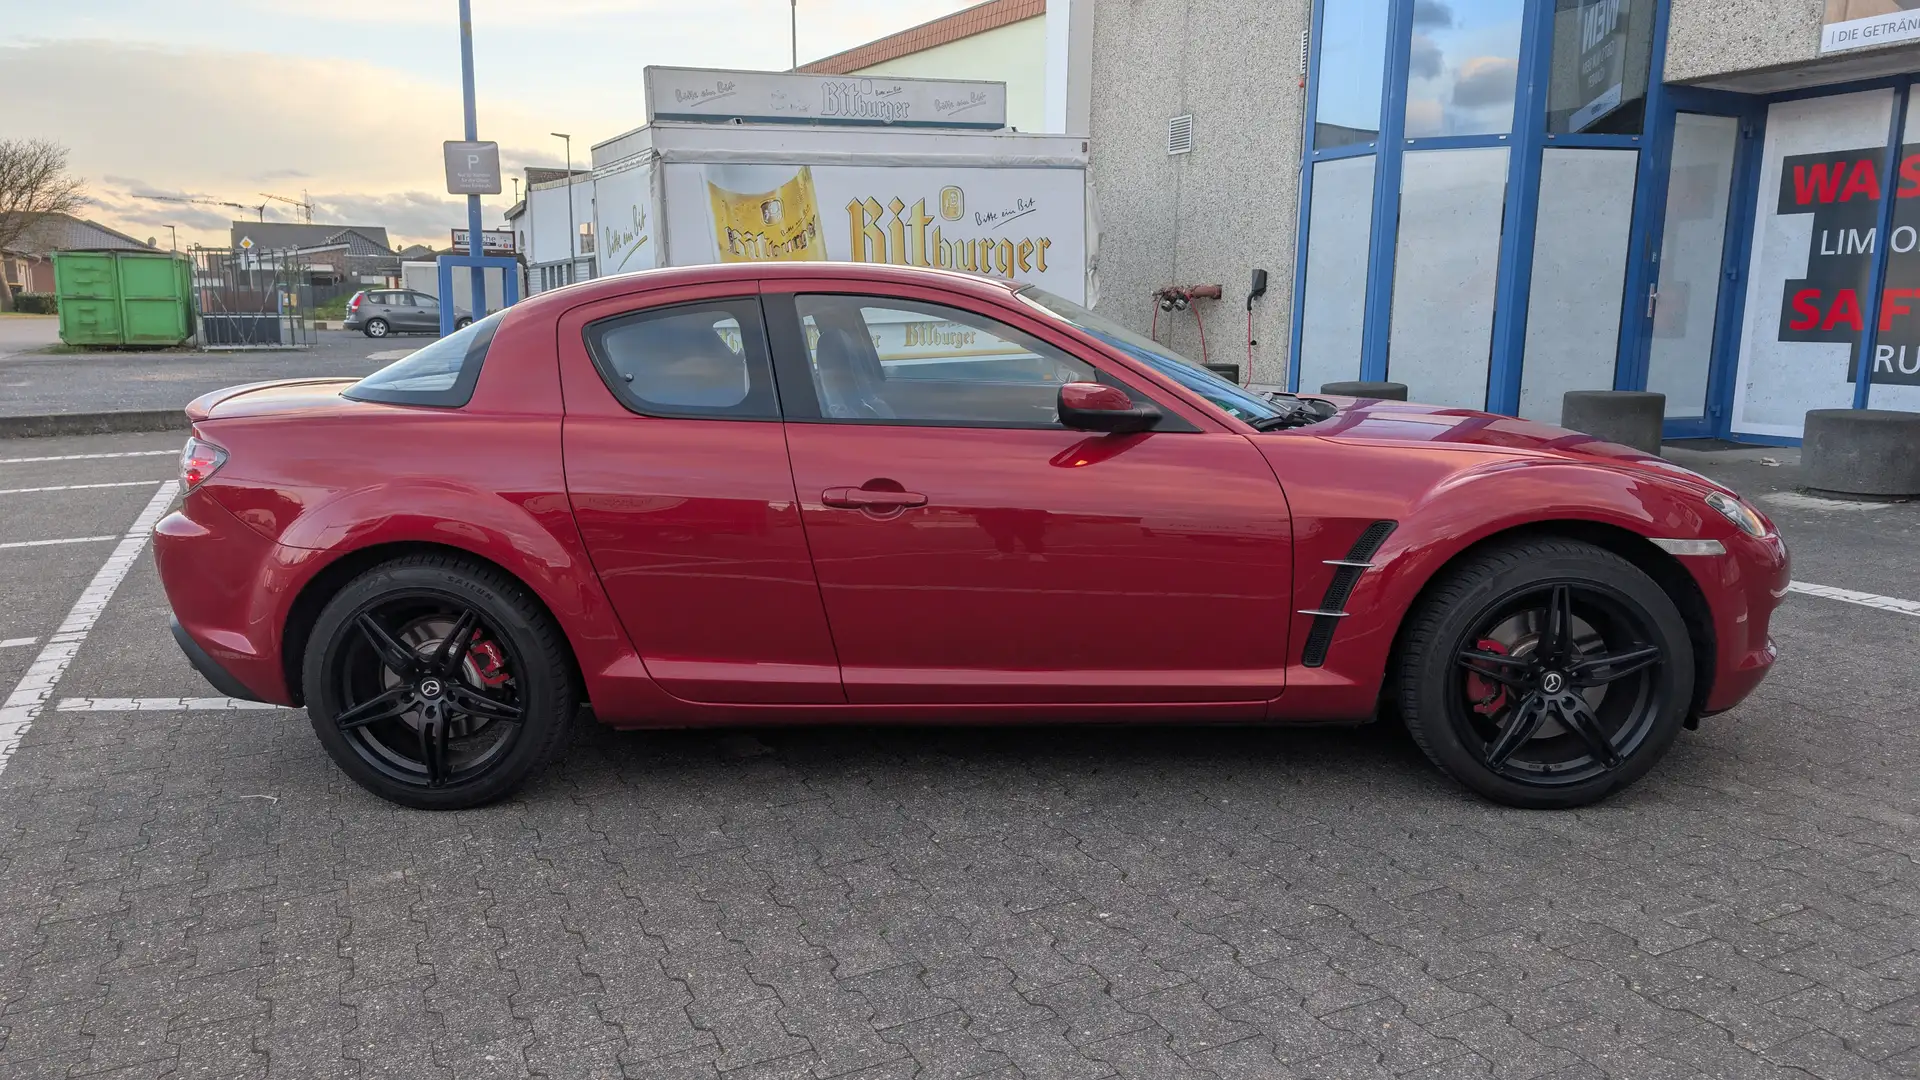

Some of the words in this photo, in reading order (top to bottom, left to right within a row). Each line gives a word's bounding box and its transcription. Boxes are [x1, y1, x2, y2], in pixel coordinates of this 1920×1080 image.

[1838, 28, 1859, 42] DIE
[1862, 18, 1920, 38] GETRÄN
[820, 81, 911, 123] Bitburger
[467, 154, 480, 171] P
[974, 211, 998, 227] Bitte
[1001, 207, 1017, 218] ein
[1017, 197, 1036, 212] Bit
[605, 225, 621, 259] Bitte
[633, 203, 647, 237] Bit
[844, 195, 1052, 280] Bitburger
[1789, 288, 1920, 332] SAF
[1873, 344, 1920, 375] RU
